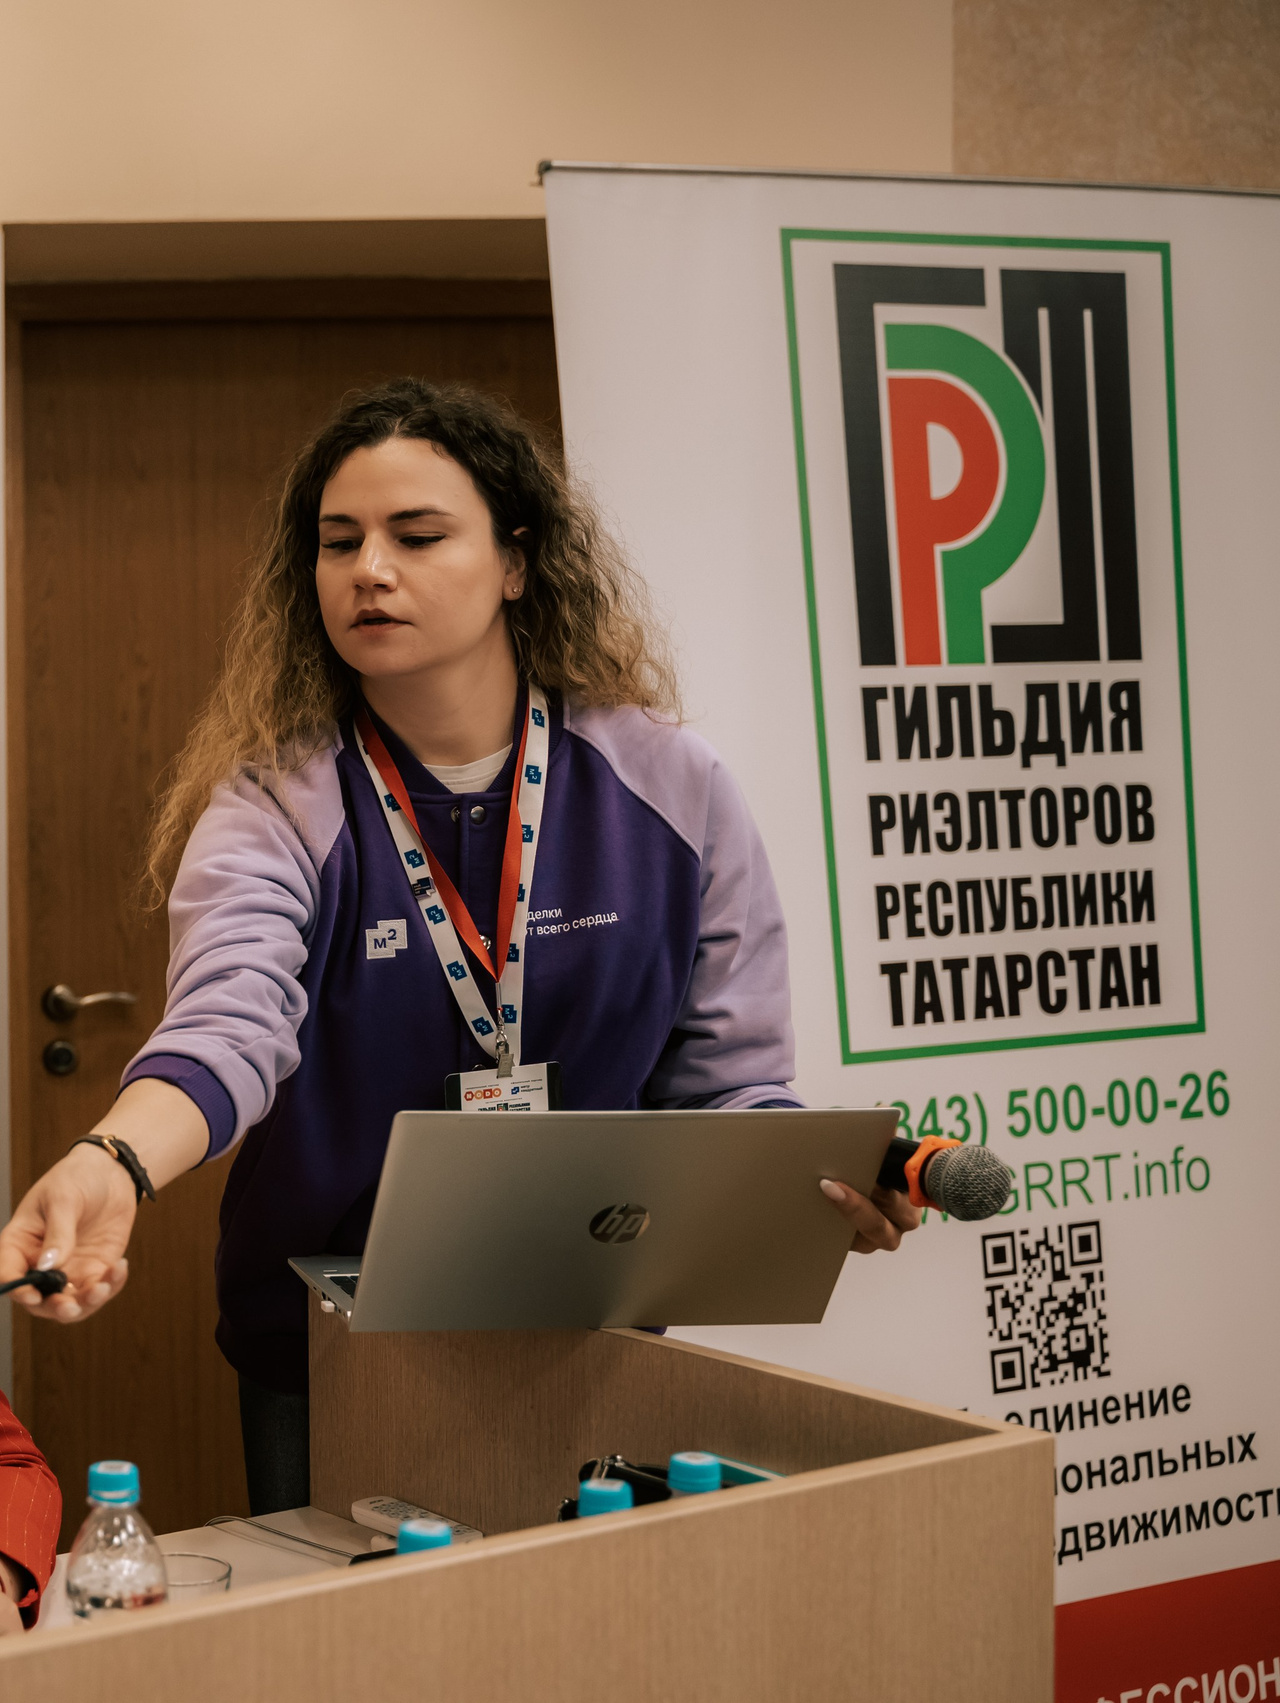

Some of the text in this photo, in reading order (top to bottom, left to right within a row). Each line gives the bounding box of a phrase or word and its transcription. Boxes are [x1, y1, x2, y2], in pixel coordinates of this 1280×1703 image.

[861, 680, 1144, 769] ГИЛЬДИЯ
[868, 783, 1155, 856] РИЭЛТОРОВ
[526, 908, 563, 922] делки
[536, 923, 570, 935] всего
[572, 911, 619, 929] сердца
[875, 870, 1157, 940] РЕСПУБЛИКИ
[880, 944, 1161, 1027] ТАТАРСТАН
[876, 1070, 1231, 1147] 843) 500-00-26
[588, 1203, 650, 1245] hp
[1004, 1382, 1192, 1434] динение
[1053, 1431, 1258, 1497] ональных
[1053, 1487, 1280, 1566] движимост
